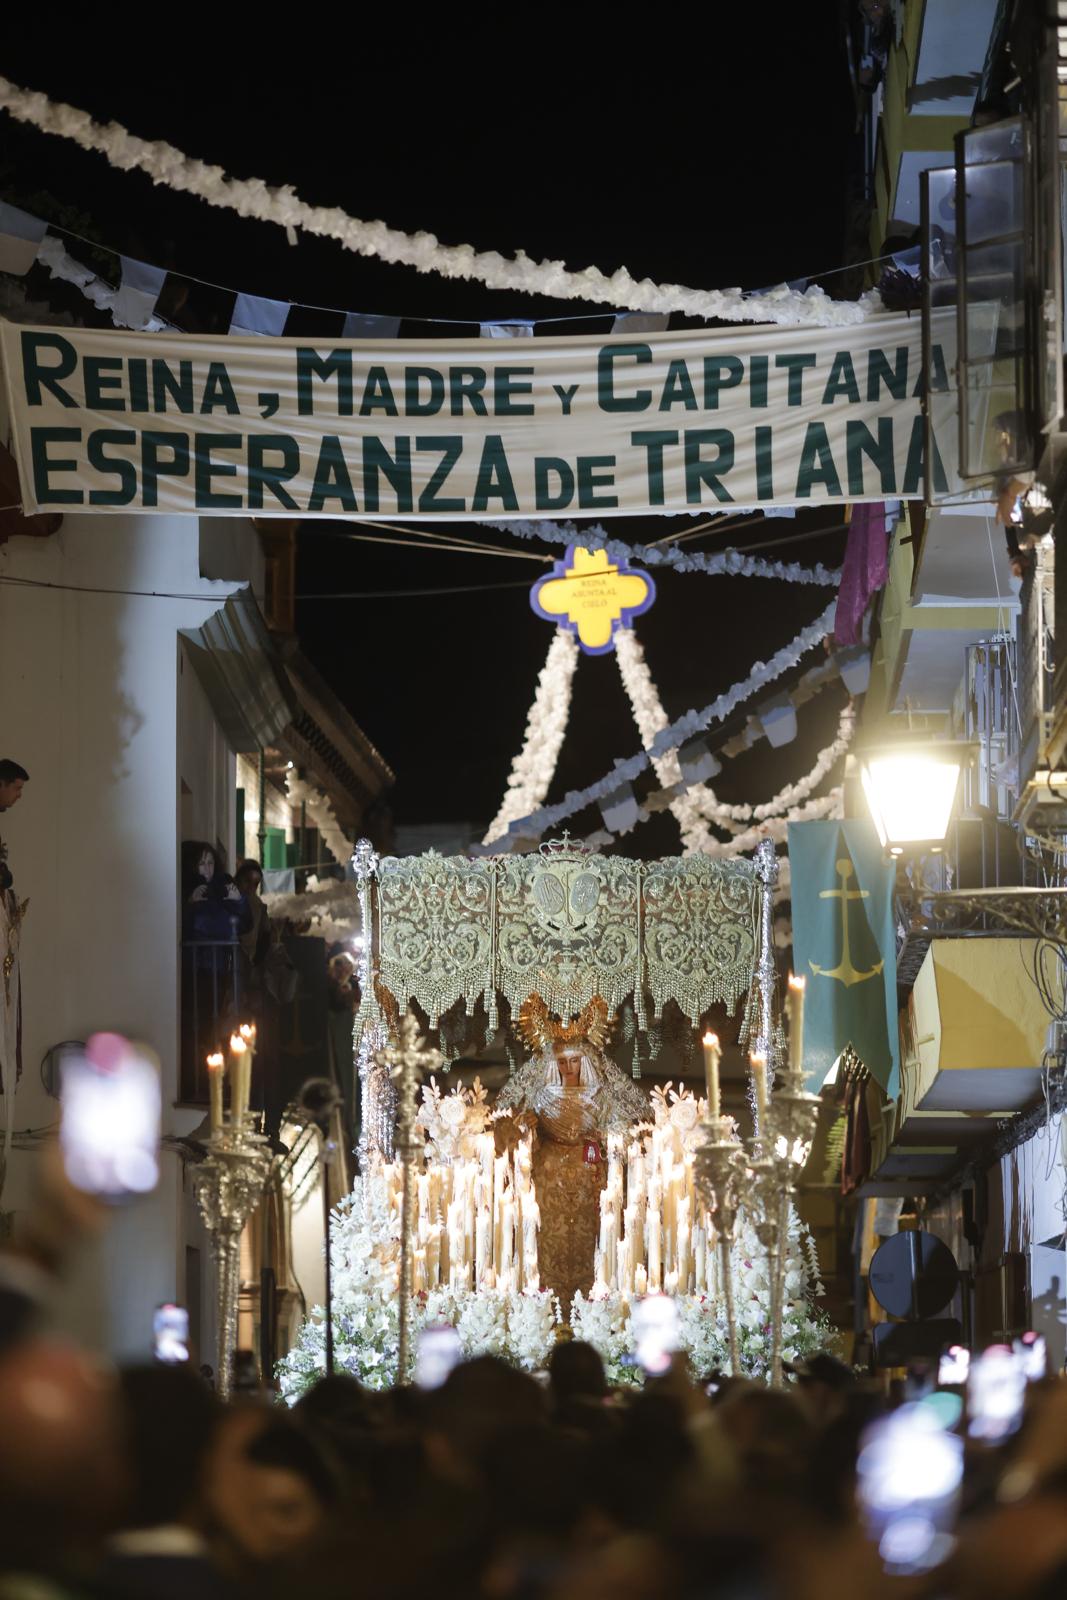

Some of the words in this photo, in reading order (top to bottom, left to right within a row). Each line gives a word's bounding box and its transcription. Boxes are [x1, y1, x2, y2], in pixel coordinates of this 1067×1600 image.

[296, 347, 535, 417] MADRE
[553, 384, 580, 415] Y
[597, 343, 949, 413] CAPITANA
[30, 426, 520, 513] ESPERANZA
[534, 455, 619, 510] DE
[631, 415, 949, 506] TRIANA
